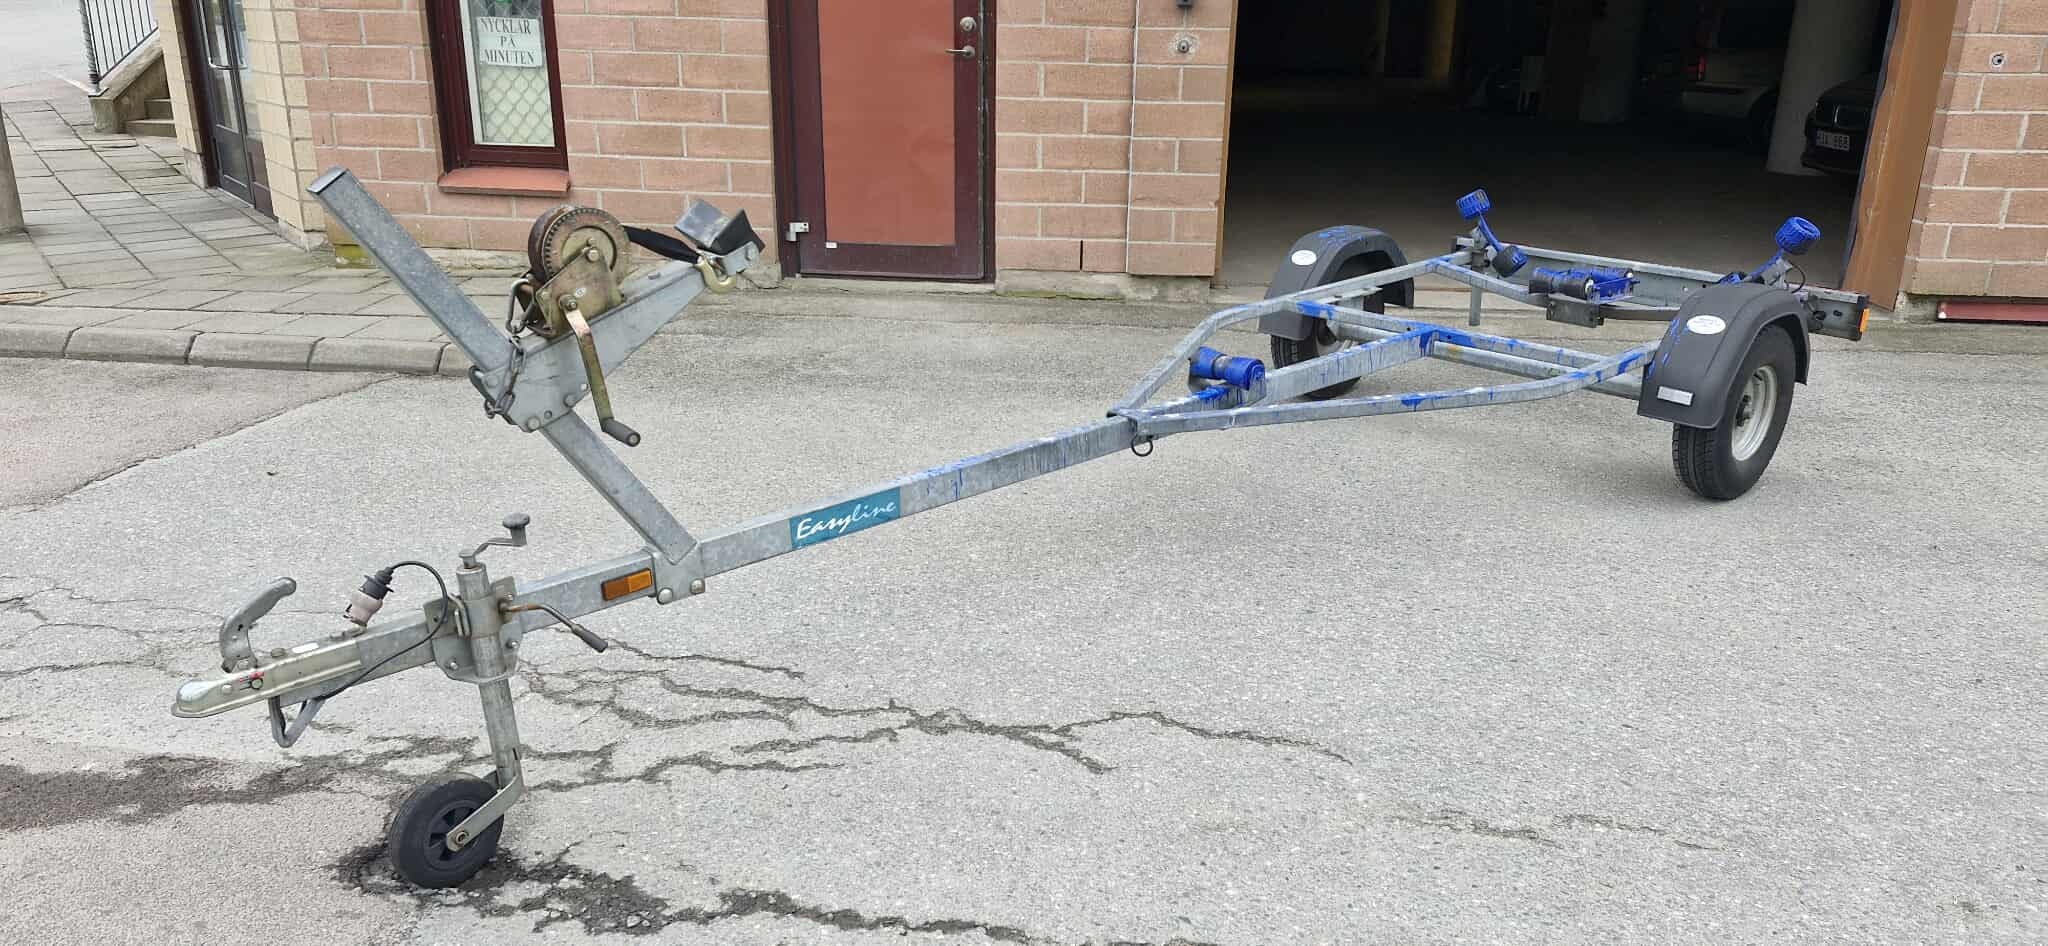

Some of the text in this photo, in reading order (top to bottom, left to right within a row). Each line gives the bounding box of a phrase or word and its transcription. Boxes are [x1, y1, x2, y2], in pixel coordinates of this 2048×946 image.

[480, 18, 531, 34] NYCKLAR
[484, 49, 534, 64] MINUTEN
[796, 502, 896, 539] Easyline
